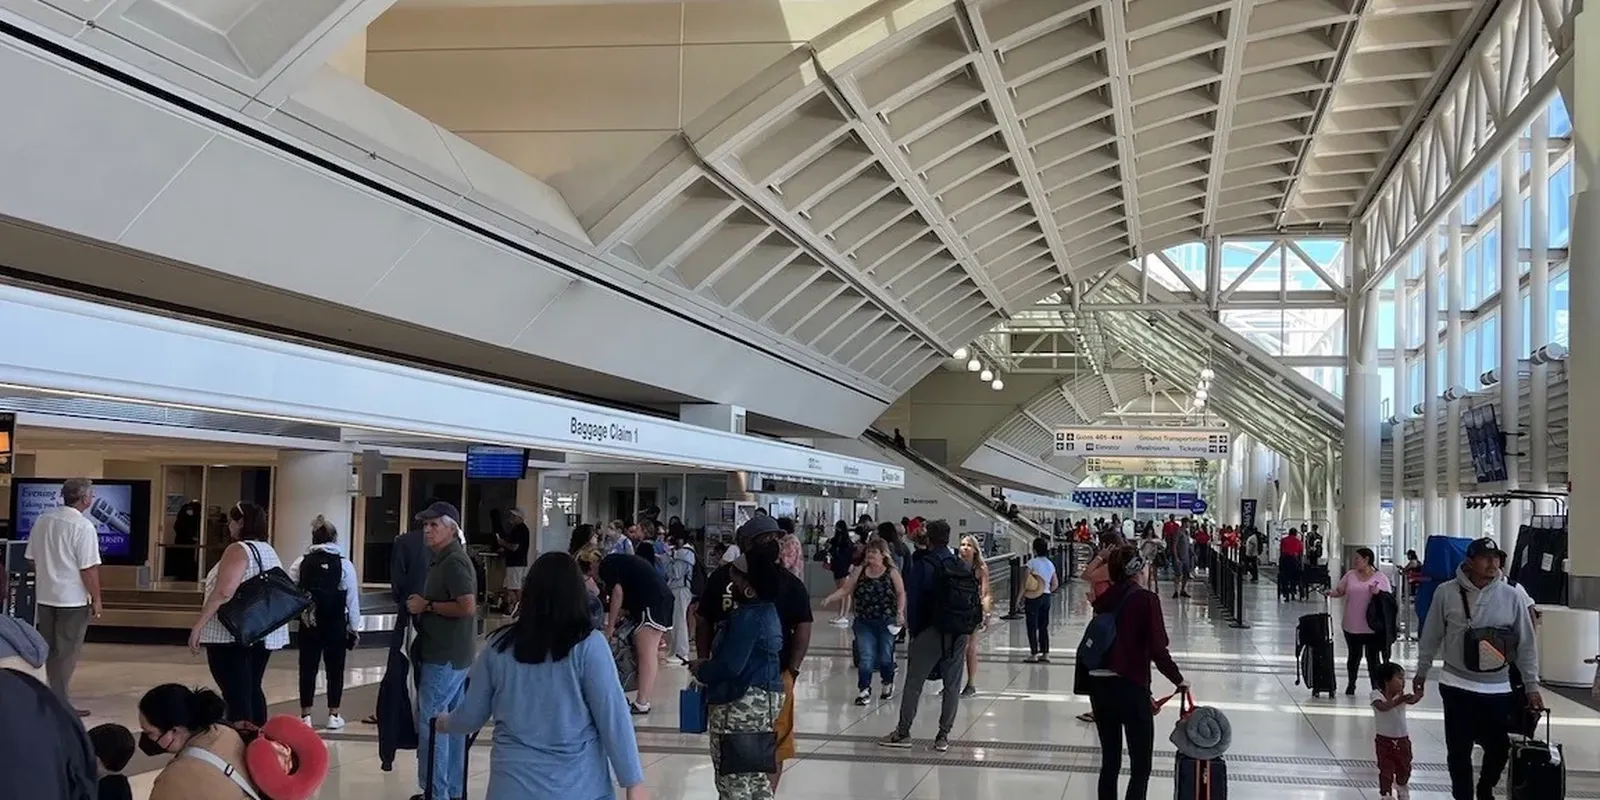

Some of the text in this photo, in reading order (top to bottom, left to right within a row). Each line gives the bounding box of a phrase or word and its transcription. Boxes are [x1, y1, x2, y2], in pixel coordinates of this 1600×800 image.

[570, 416, 639, 443] Baggage Claim 1
[1163, 435, 1207, 443] Transportation
[1179, 445, 1207, 453] Ticketing
[21, 486, 57, 500] Evening
